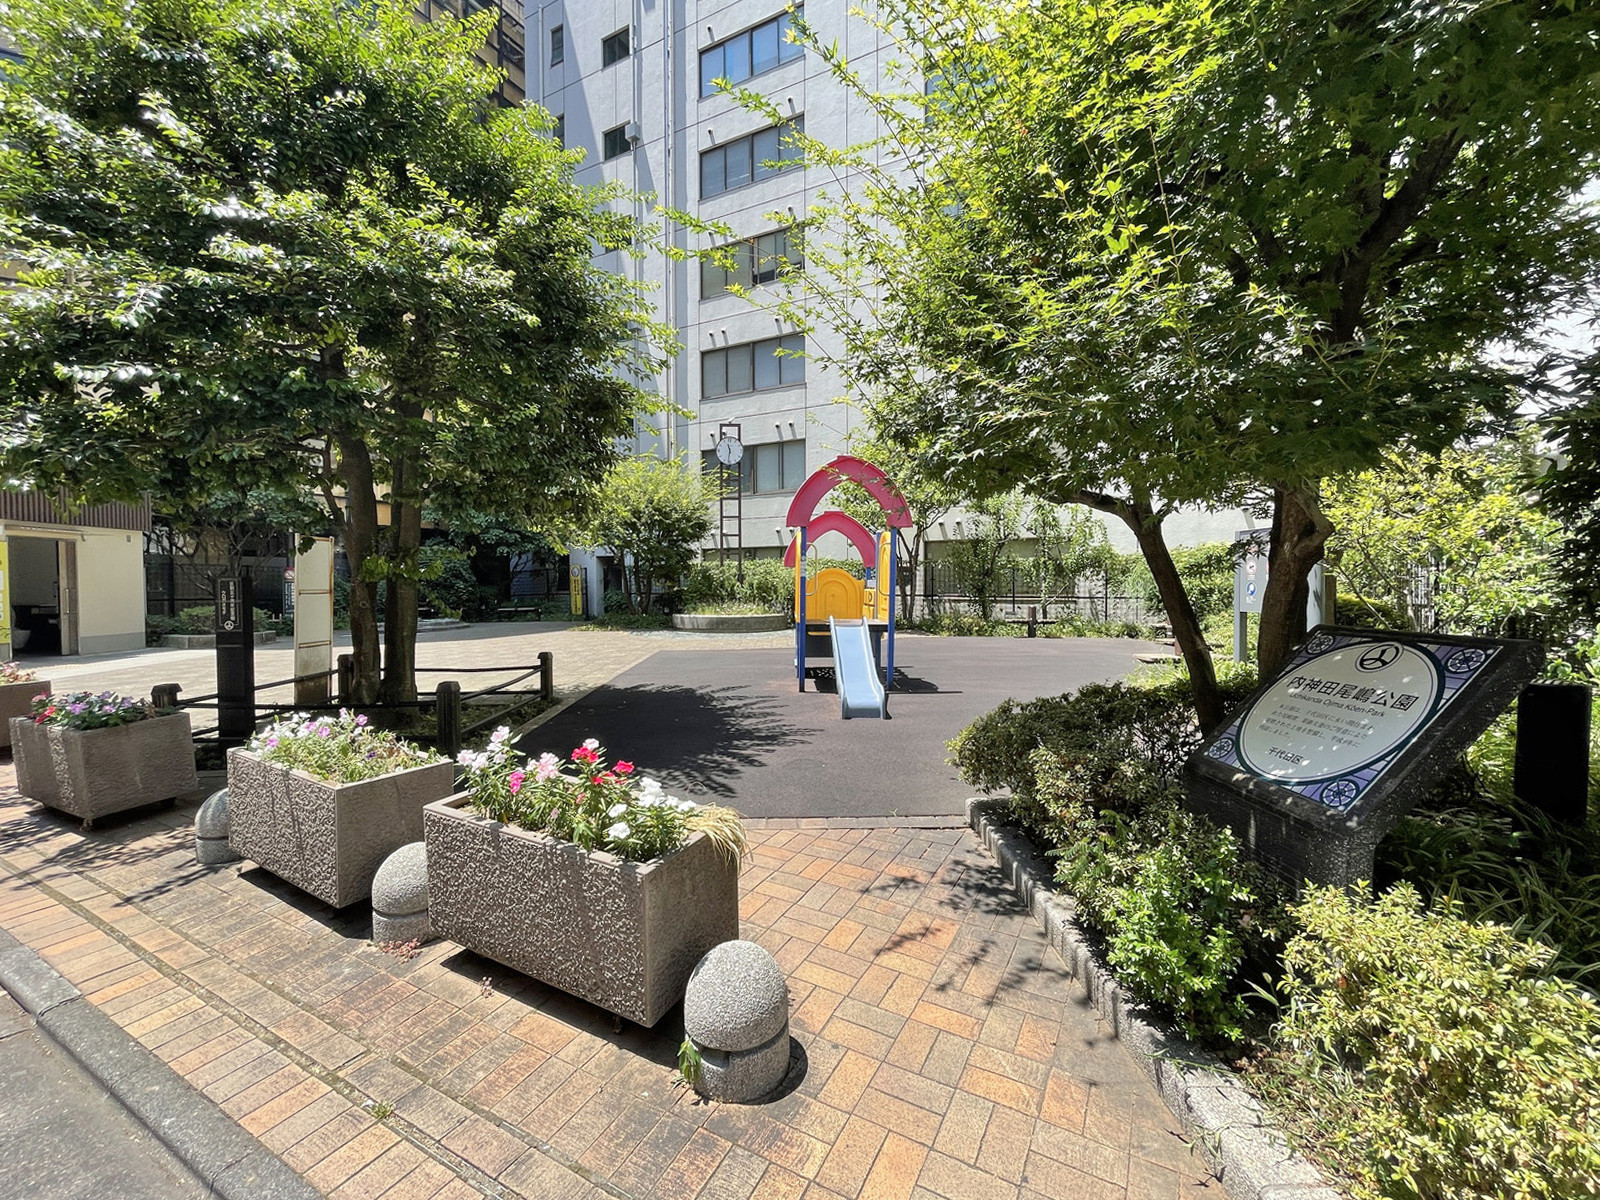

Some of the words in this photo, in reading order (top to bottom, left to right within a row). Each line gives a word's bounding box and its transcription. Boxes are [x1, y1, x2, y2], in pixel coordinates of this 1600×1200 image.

[1287, 675, 1419, 712] 内神田尾嶋公園
[1267, 746, 1305, 765] 千代田区
